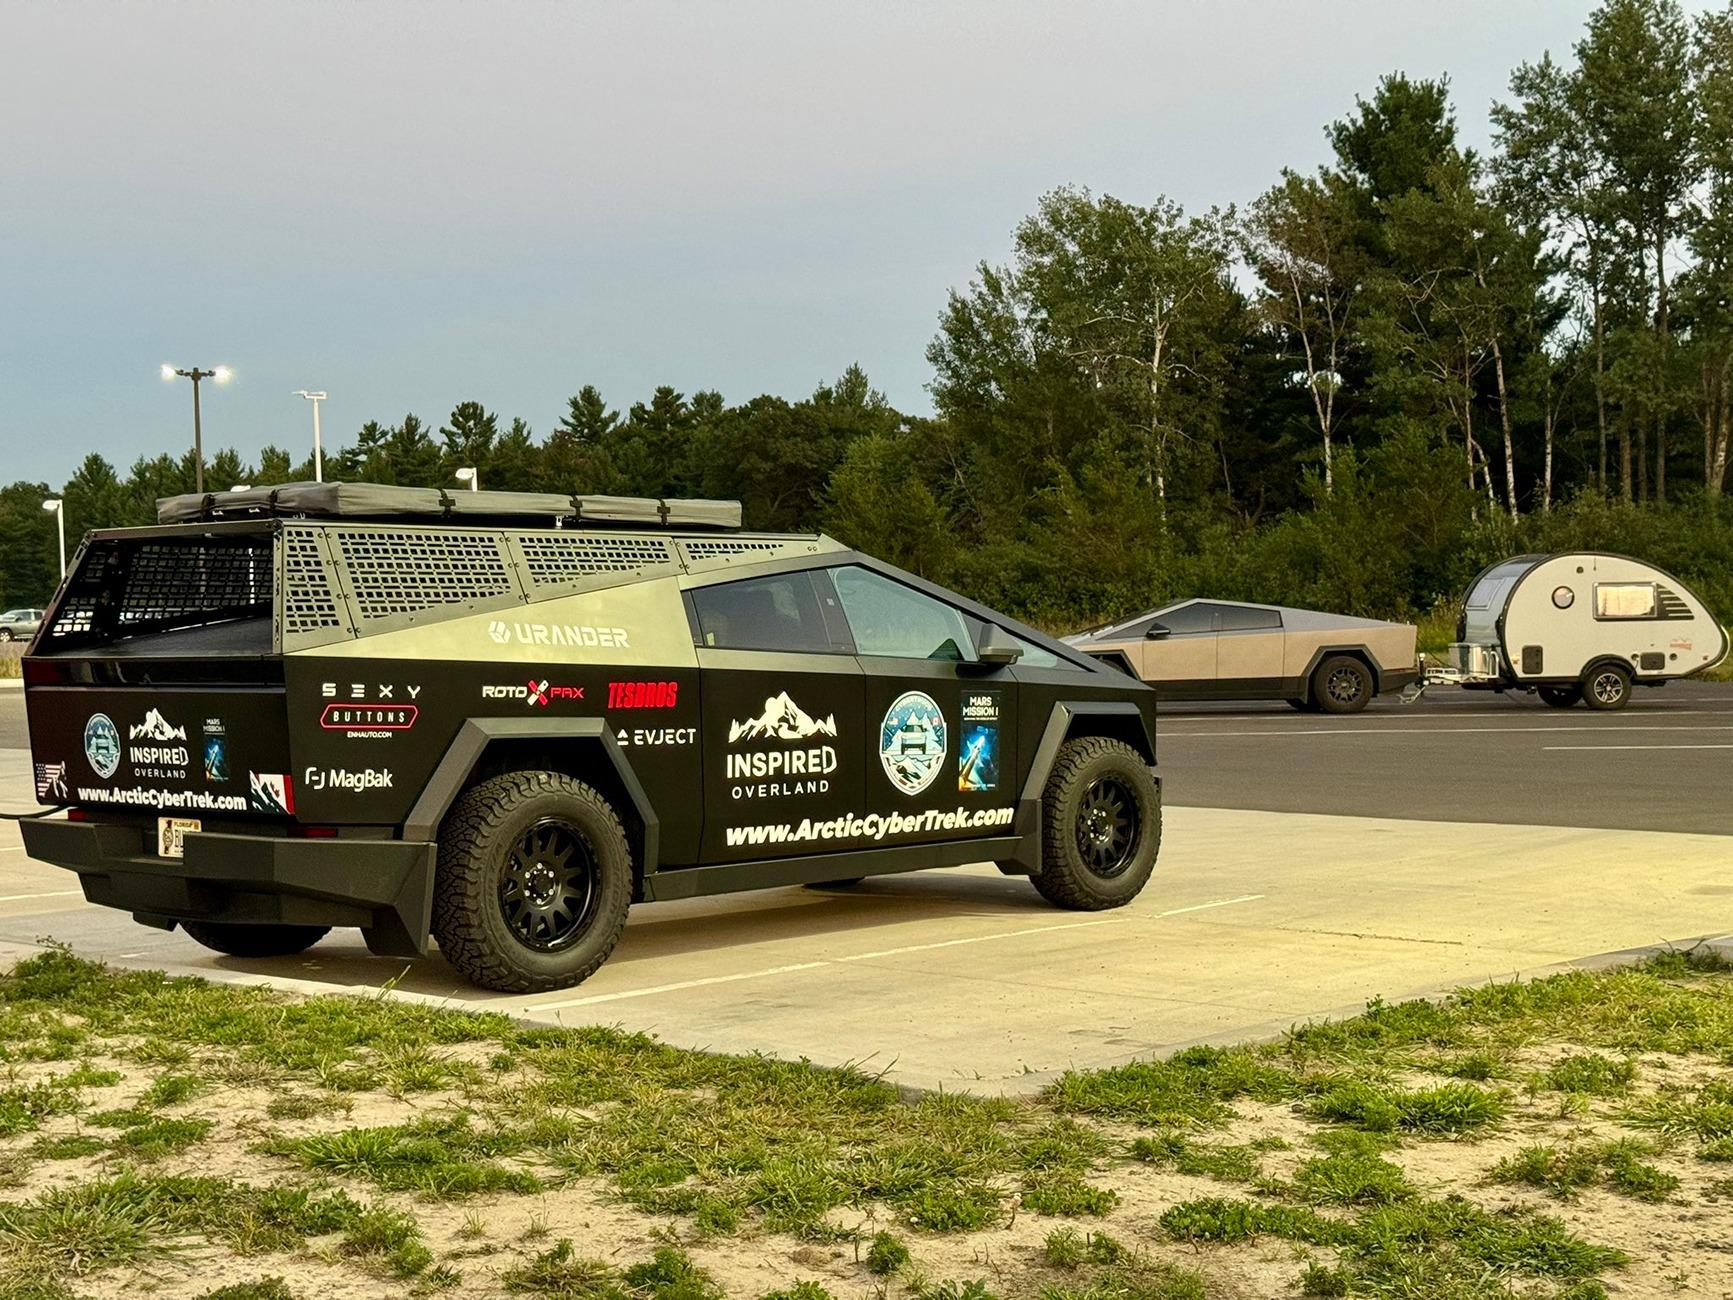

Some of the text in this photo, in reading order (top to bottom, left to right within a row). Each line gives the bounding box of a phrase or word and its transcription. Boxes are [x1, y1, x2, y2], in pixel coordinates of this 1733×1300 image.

[514, 623, 630, 648] URANDER
[607, 682, 678, 709] TESBROS
[969, 696, 993, 707] MARS
[333, 710, 405, 723] BUTTONS
[962, 706, 995, 717] MISSION
[634, 728, 697, 746] EVJECT
[129, 746, 190, 766] INSPIRED
[726, 746, 838, 779] INSPIRED
[134, 767, 186, 780] OVERLAND
[329, 768, 393, 793] MagBak
[77, 786, 248, 811] www.ArcticCyberTrek.com
[731, 780, 830, 800] OVERLAND
[725, 805, 1015, 847] www.ArcticCyberTrek.com
